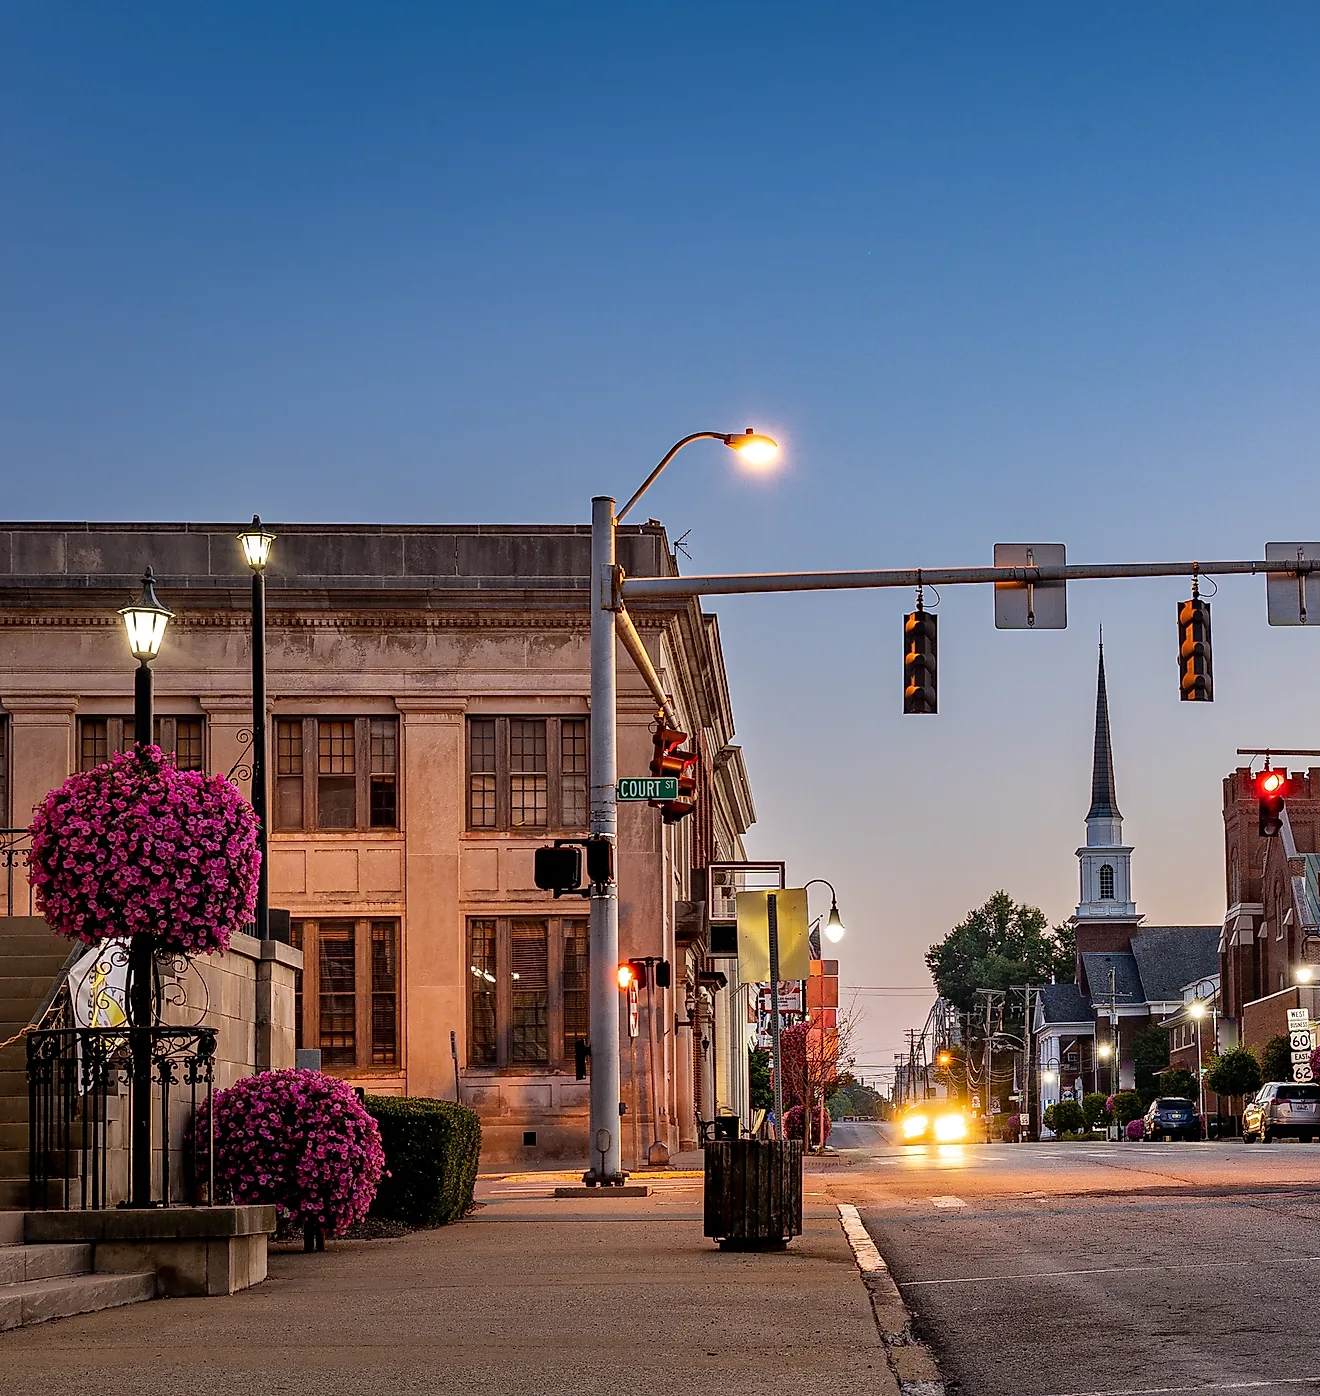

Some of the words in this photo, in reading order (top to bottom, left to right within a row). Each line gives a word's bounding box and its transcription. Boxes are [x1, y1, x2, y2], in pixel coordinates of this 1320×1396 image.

[621, 780, 661, 797] COURT
[665, 780, 675, 789] ST
[1293, 1034, 1308, 1047] 60
[1296, 1067, 1312, 1079] 62
